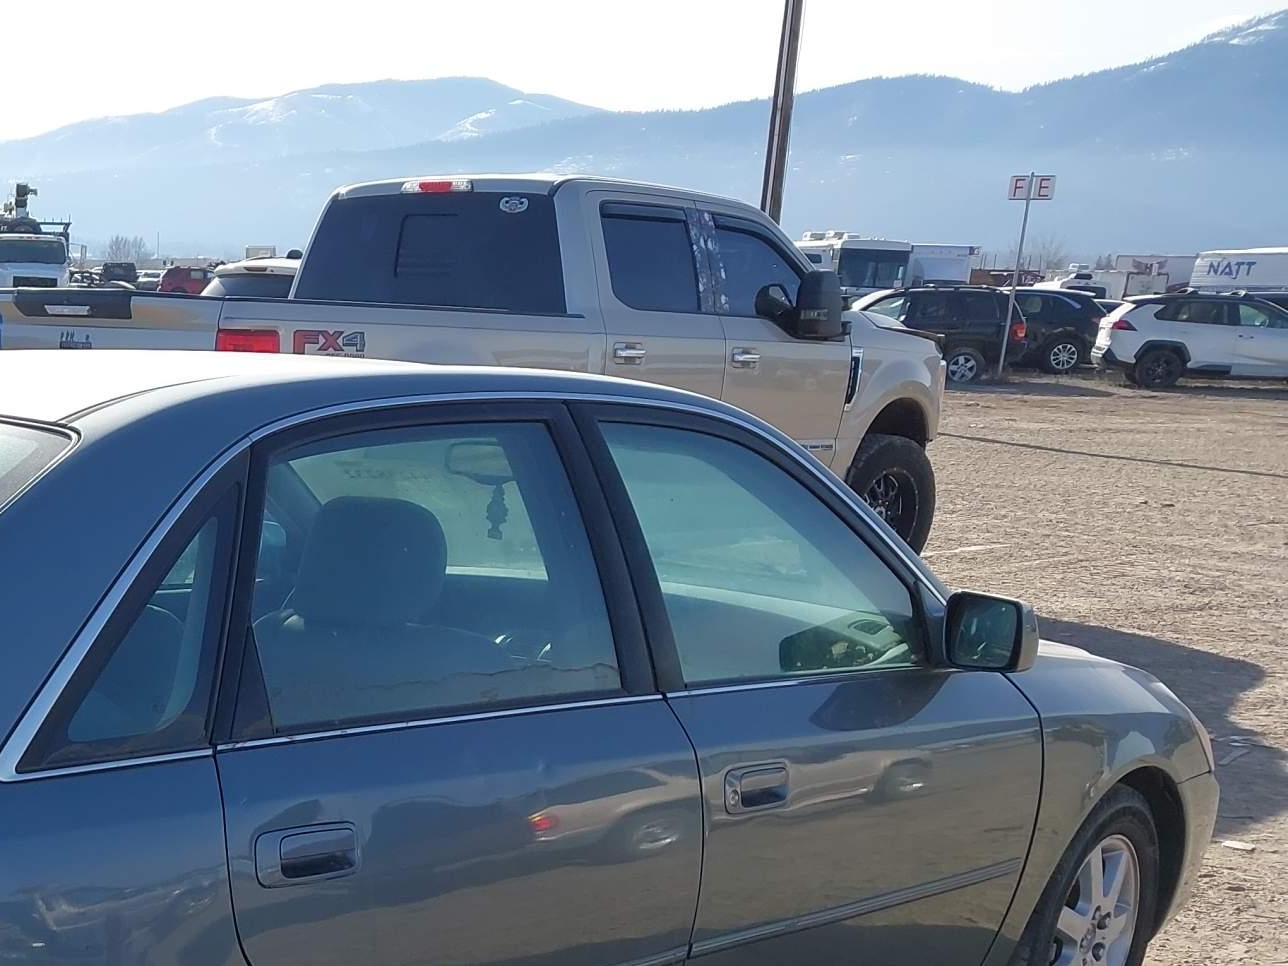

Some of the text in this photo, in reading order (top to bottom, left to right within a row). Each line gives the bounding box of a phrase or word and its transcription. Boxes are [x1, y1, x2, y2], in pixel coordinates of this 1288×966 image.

[1013, 178, 1026, 197] F
[1038, 178, 1050, 197] E
[293, 329, 365, 354] FX4
